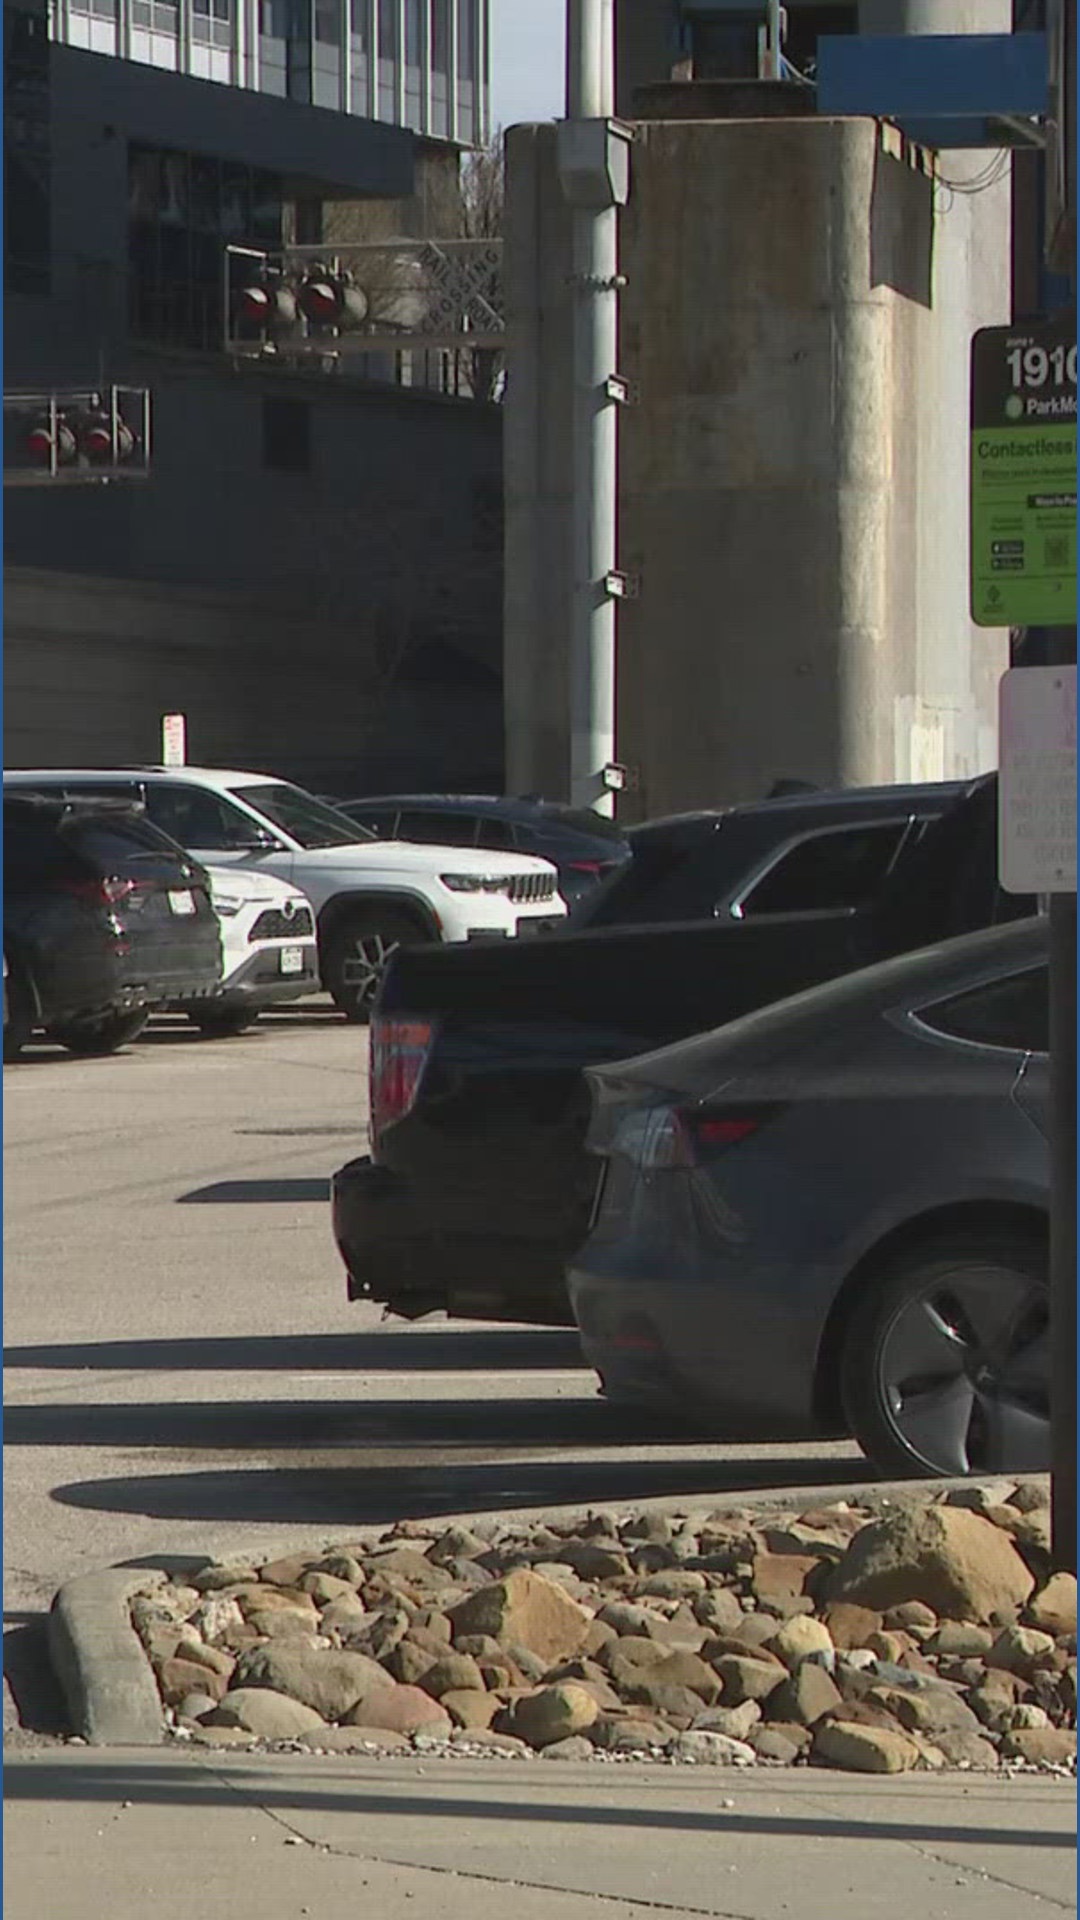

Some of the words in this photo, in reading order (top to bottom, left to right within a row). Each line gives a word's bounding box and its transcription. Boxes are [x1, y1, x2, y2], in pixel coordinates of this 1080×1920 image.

[418, 244, 450, 287] RAIL
[421, 248, 499, 333] CROSSING
[978, 438, 1073, 459] Contactless
